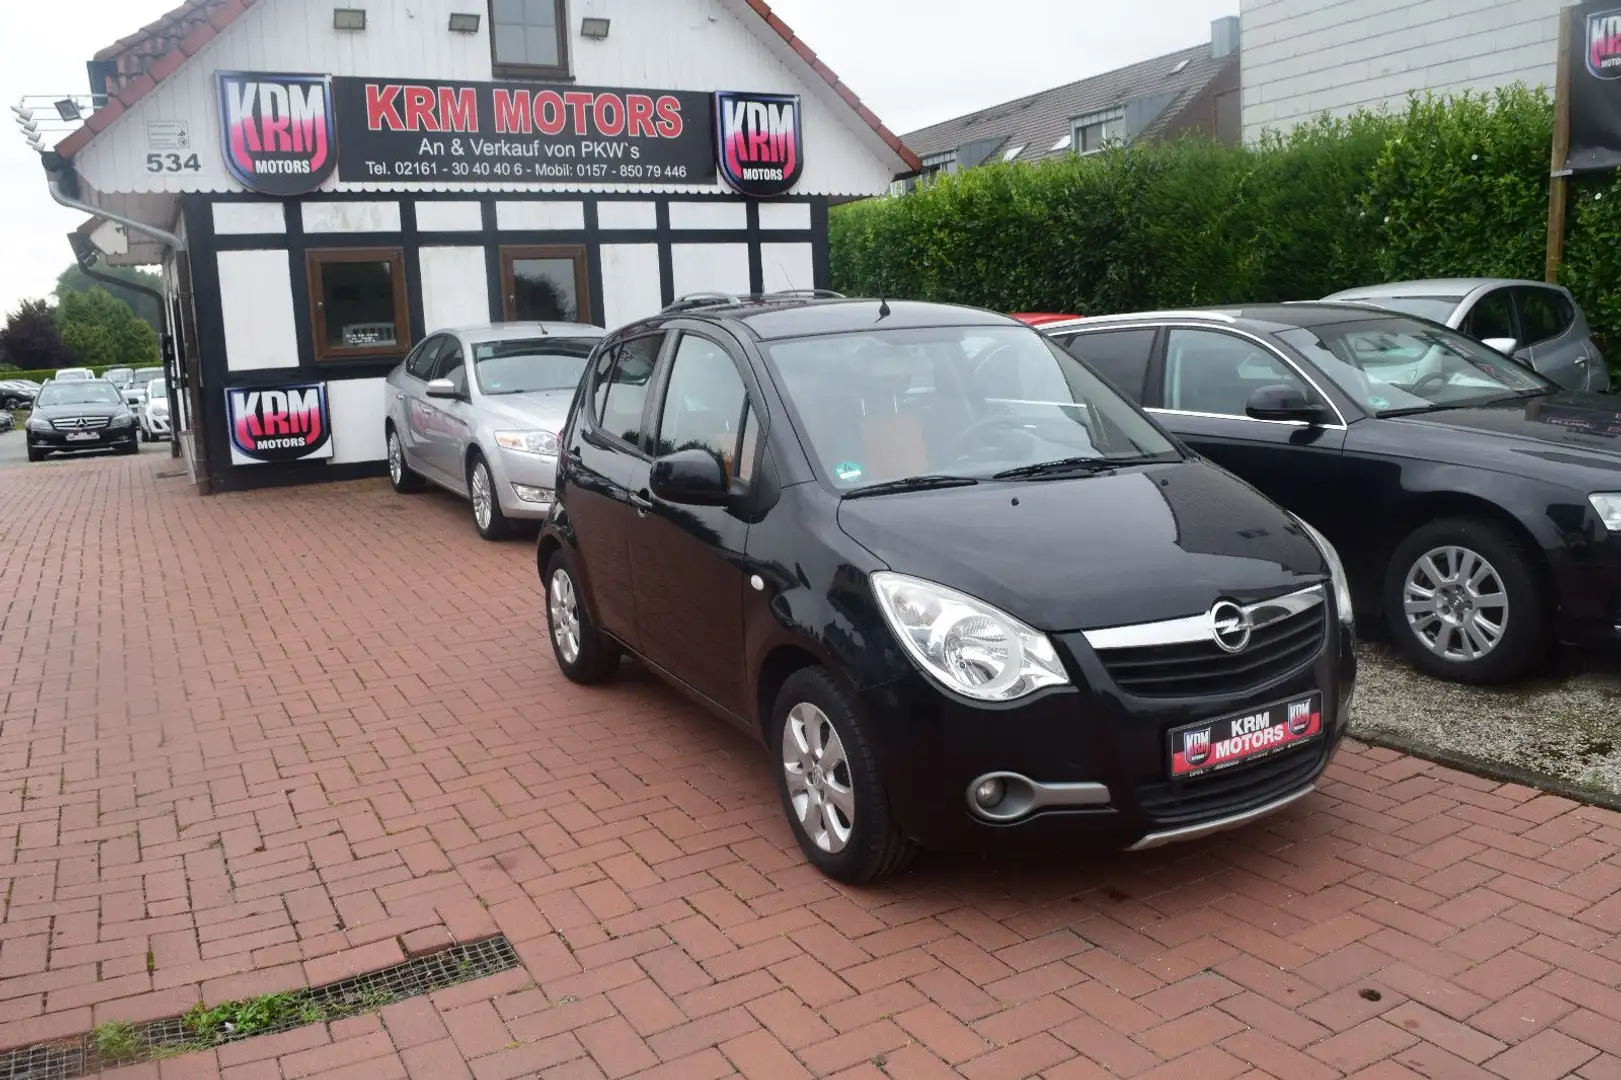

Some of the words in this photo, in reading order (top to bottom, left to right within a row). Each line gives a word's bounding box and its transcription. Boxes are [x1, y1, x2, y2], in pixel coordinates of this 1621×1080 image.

[1591, 15, 1621, 68] KR
[365, 84, 479, 132] KRM
[493, 88, 683, 138] MOTORS
[227, 82, 328, 172] KRM
[724, 100, 796, 179] KRM
[419, 138, 445, 155] An
[451, 138, 465, 155] &
[470, 138, 540, 157] Verkauf
[544, 144, 575, 157] von
[146, 153, 201, 172] 534
[255, 160, 311, 174] MOTORS
[365, 161, 391, 175] Tel.
[395, 161, 437, 175] 02161
[452, 162, 469, 175] 30
[472, 162, 490, 175] 40
[493, 163, 510, 176] 40
[514, 163, 523, 176] 6
[535, 163, 573, 176] Mobil:
[577, 164, 607, 177] 0157
[620, 164, 643, 177] 850
[645, 165, 661, 178] 79
[664, 166, 687, 178] 446
[743, 168, 783, 181] MOTORS
[233, 388, 321, 451] KRM
[257, 437, 306, 450] MOTORS
[1231, 711, 1270, 737] KRM
[1215, 724, 1284, 759] MOTORS
